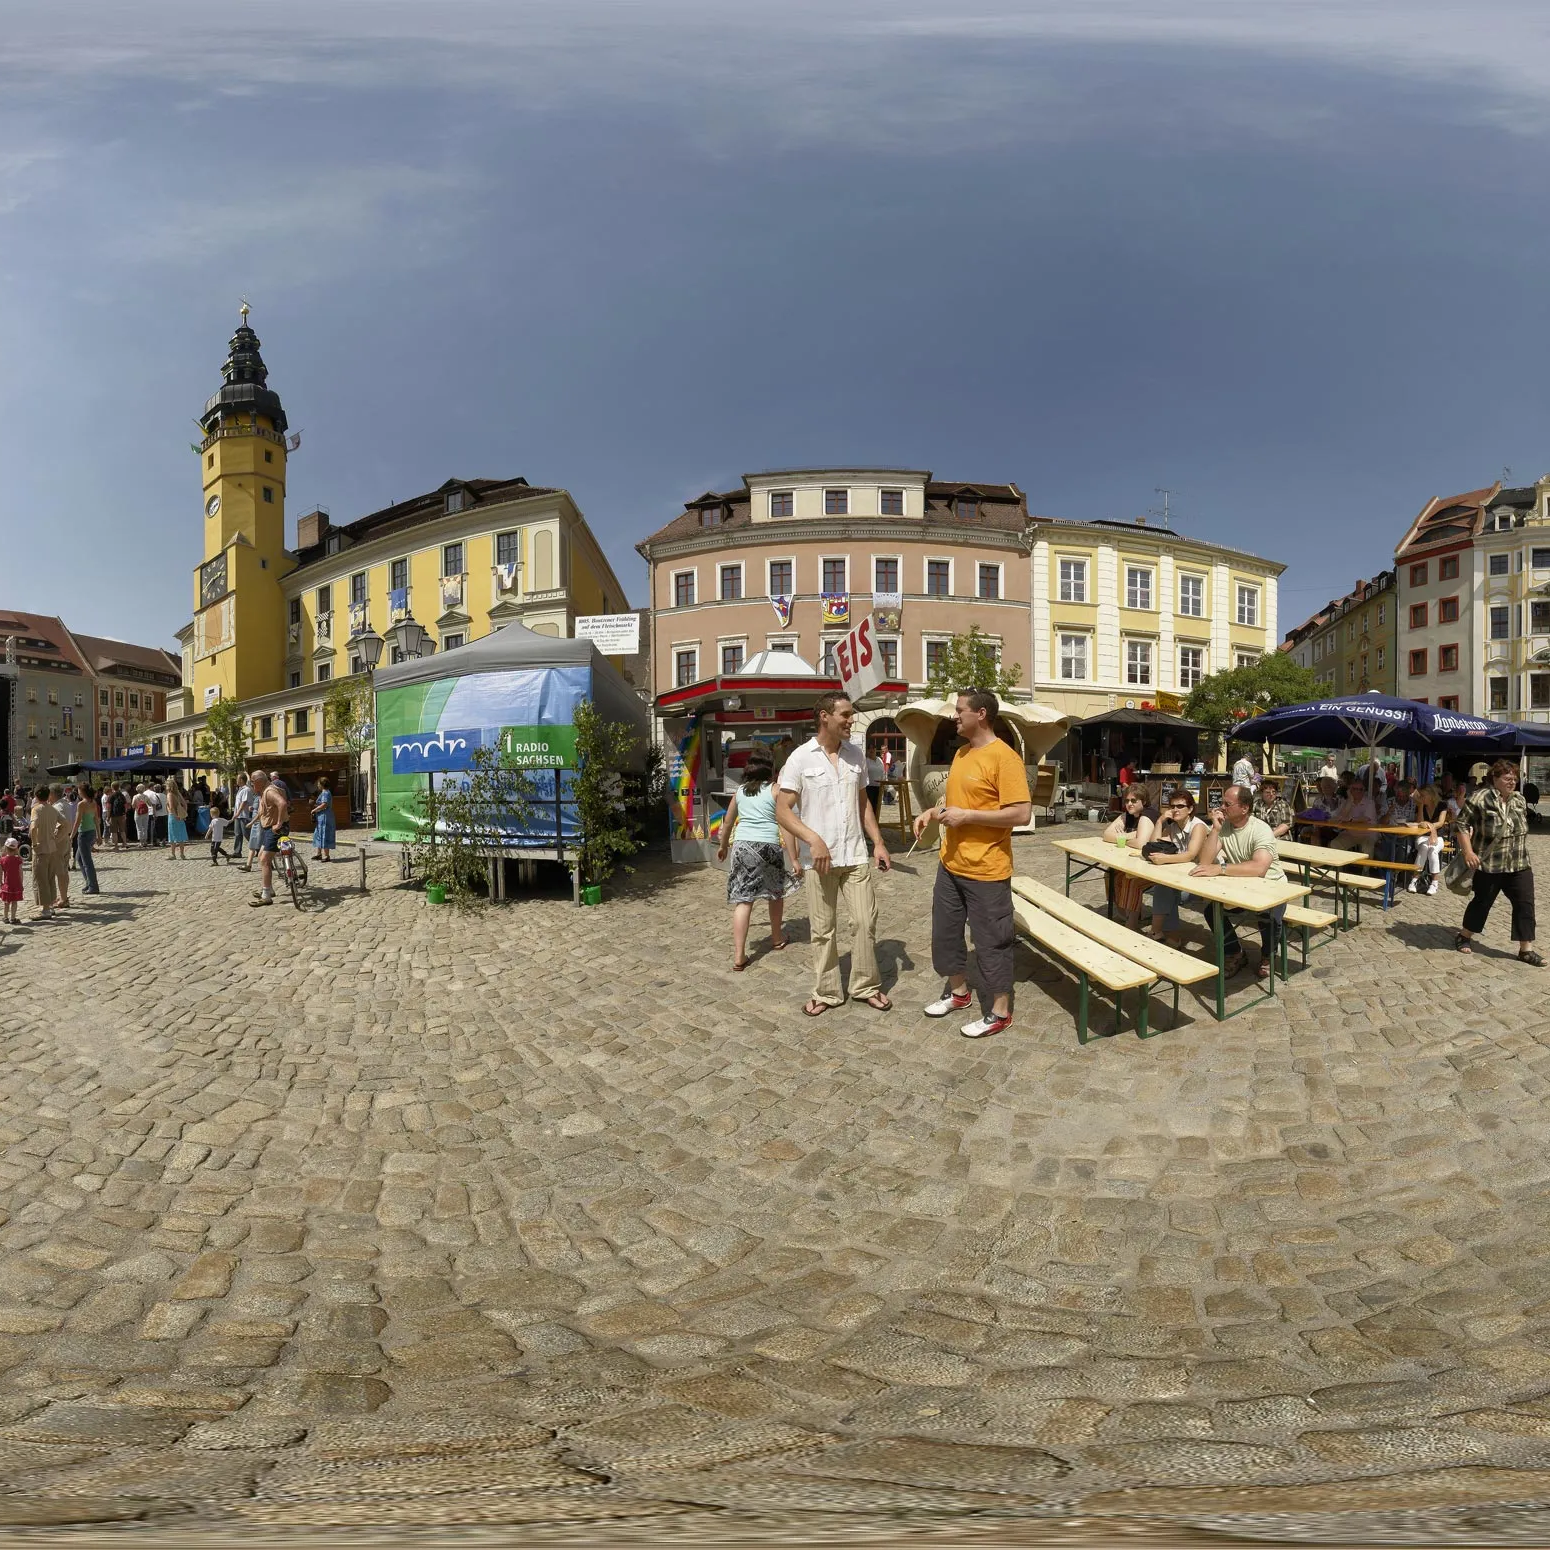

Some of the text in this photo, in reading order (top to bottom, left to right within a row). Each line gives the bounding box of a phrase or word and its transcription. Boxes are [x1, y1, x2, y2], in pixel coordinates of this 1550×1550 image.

[837, 618, 872, 682] EIS
[1432, 714, 1486, 732] Landskron
[393, 731, 466, 760] mdr
[517, 743, 549, 753] RADIO
[517, 755, 564, 766] SACHSEN
